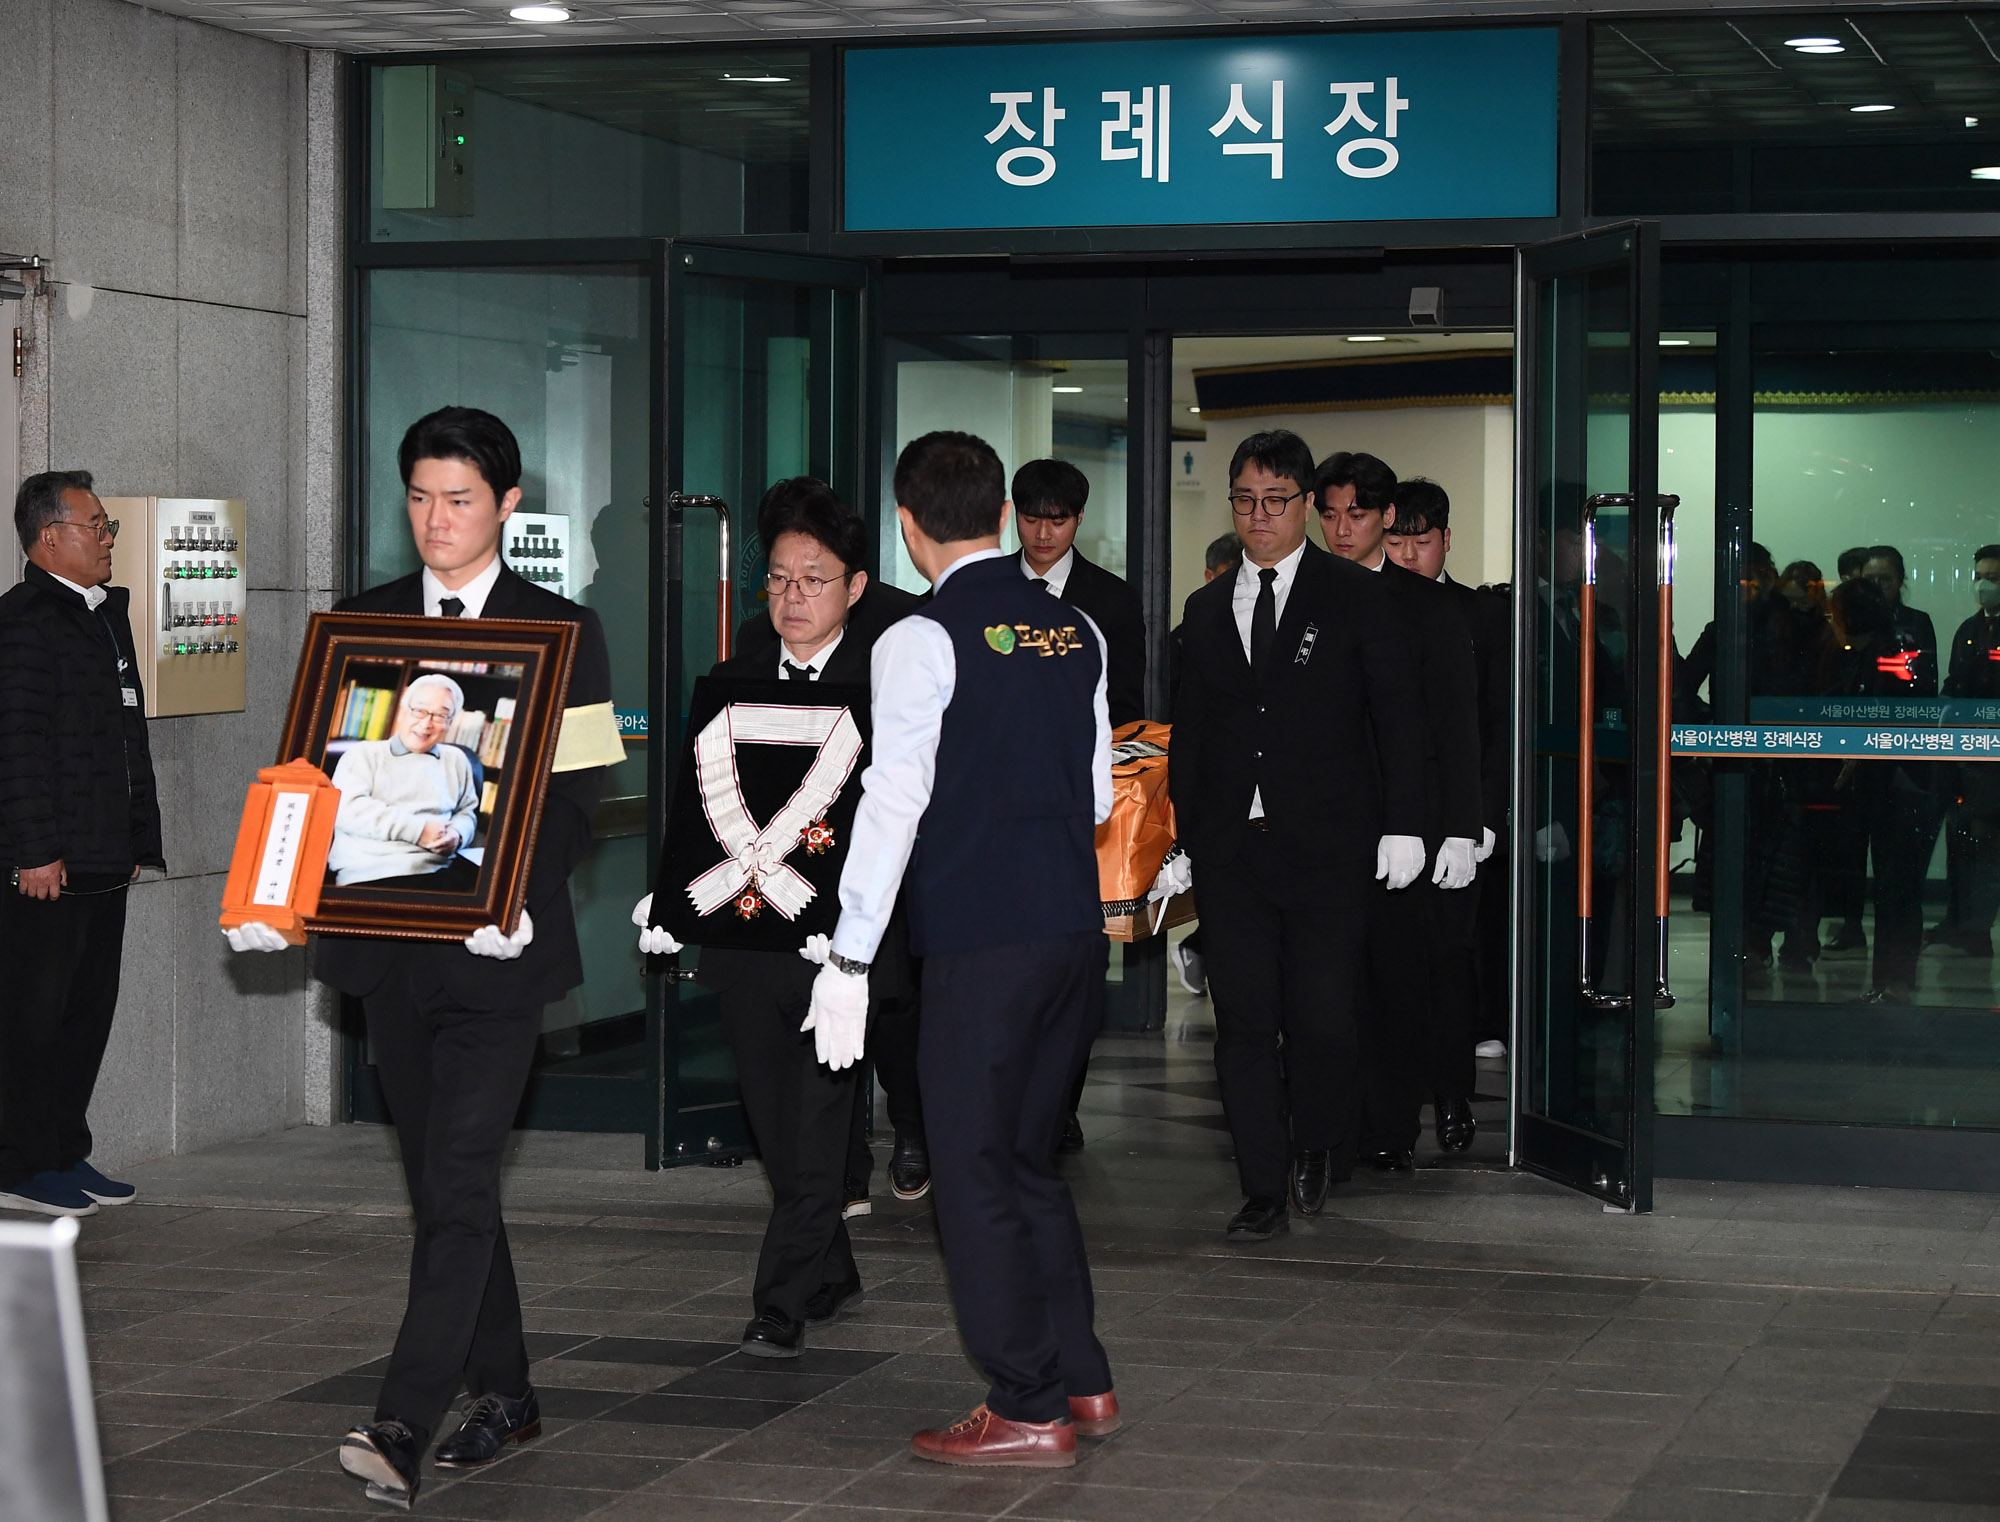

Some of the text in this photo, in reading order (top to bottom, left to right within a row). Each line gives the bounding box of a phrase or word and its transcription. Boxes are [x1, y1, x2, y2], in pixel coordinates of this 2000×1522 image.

[984, 76, 1409, 187] 장례식장
[1820, 704, 1890, 719] 서울아산병원
[1671, 729, 1823, 748] 서울아산병원 장례식장
[1863, 731, 1954, 750] 서울아산병원
